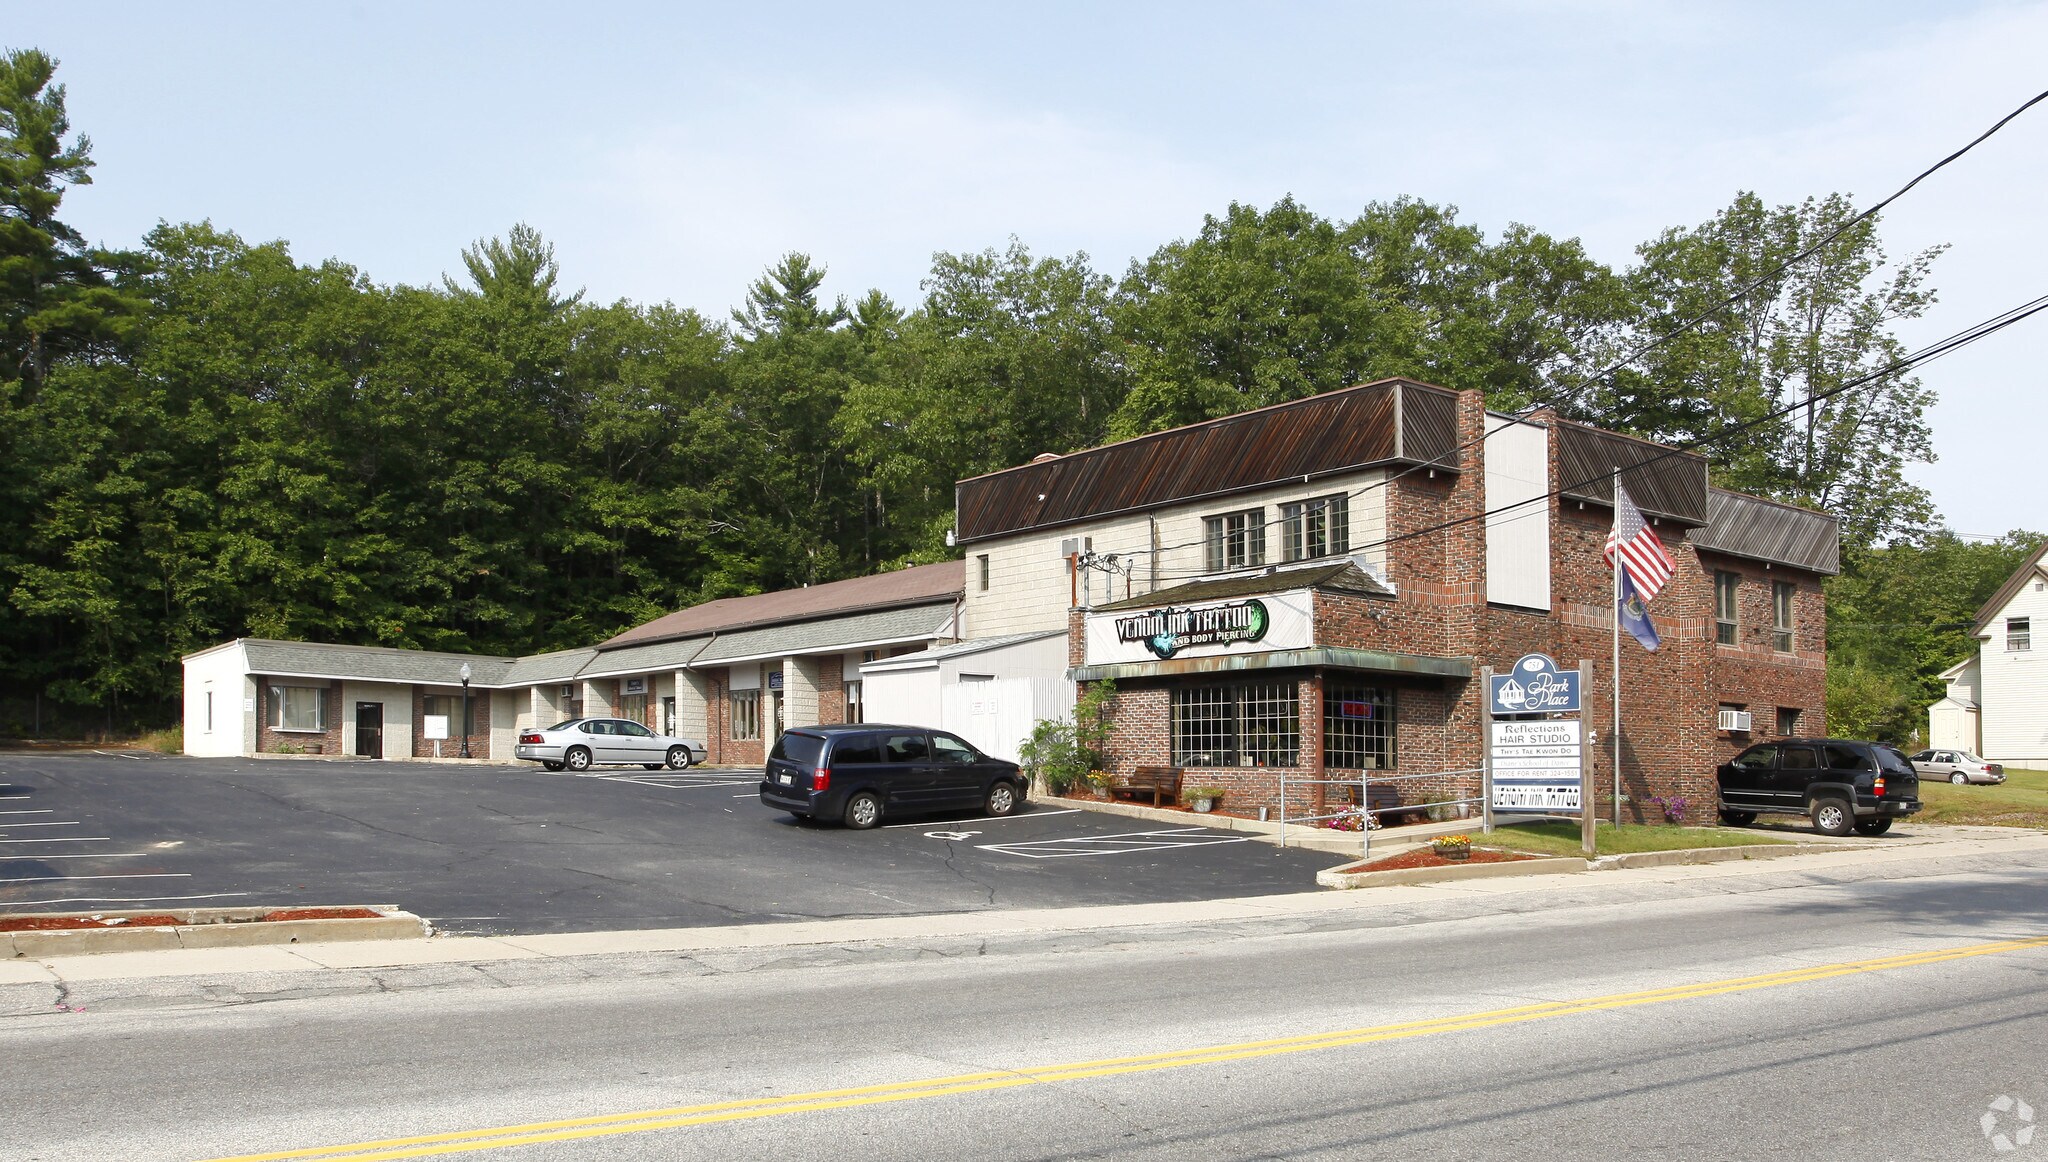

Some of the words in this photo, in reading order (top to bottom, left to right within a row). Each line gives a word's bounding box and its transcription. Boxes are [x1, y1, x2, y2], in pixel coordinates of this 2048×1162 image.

[1116, 615, 1164, 643] VENOM
[1168, 611, 1190, 634] INK
[1193, 606, 1253, 632] TATTOO
[1172, 637, 1190, 646] AND
[1192, 633, 1214, 644] BODY
[1216, 630, 1256, 642] PIERCING
[1528, 661, 1540, 670] 751
[1527, 672, 1569, 695] Park
[1525, 688, 1569, 710] Place
[1505, 725, 1566, 734] Reflections
[1500, 735, 1524, 744] HAIR
[1530, 734, 1571, 743] STUDIO
[1546, 787, 1578, 806] TATTOO
